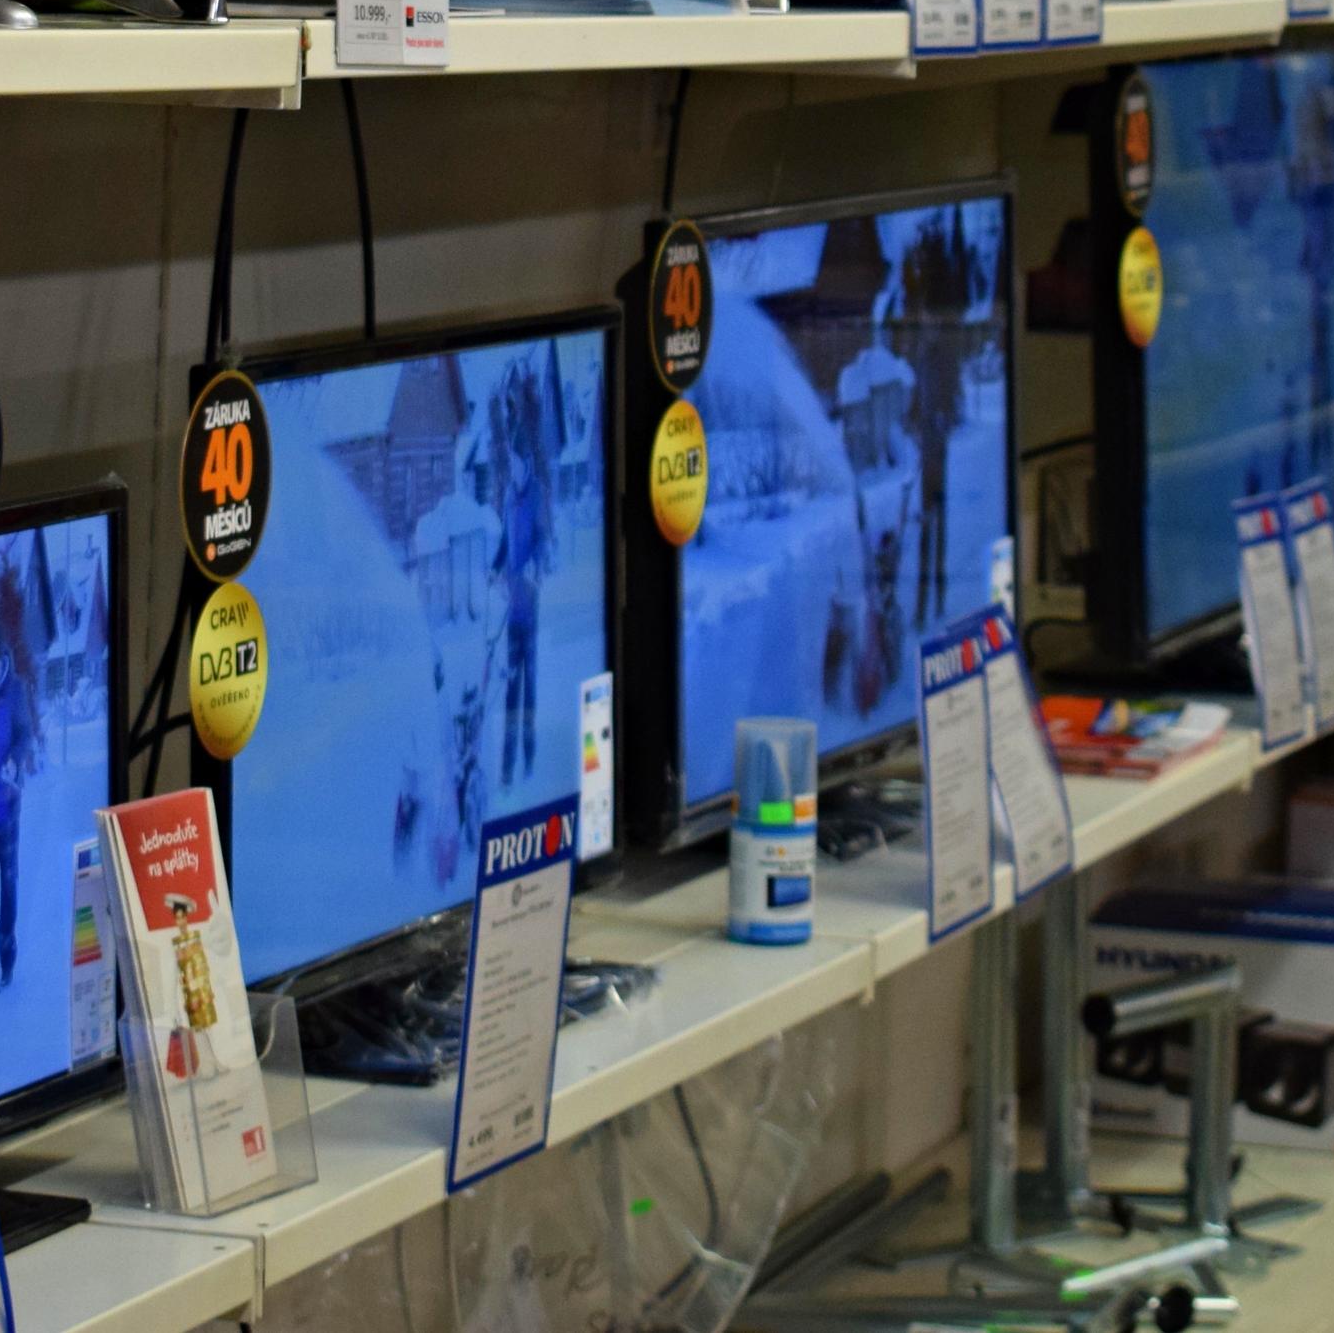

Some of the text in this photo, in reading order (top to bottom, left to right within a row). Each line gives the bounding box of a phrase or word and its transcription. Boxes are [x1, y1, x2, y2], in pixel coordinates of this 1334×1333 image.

[663, 264, 702, 331] 40
[204, 398, 251, 432] ZÁRUKA
[201, 422, 253, 505] 40
[204, 504, 253, 542] MĚSÍCŮ
[210, 607, 237, 632] CRA
[237, 640, 258, 674] T2
[139, 816, 199, 855] Jednoduše
[163, 853, 200, 878] splátky
